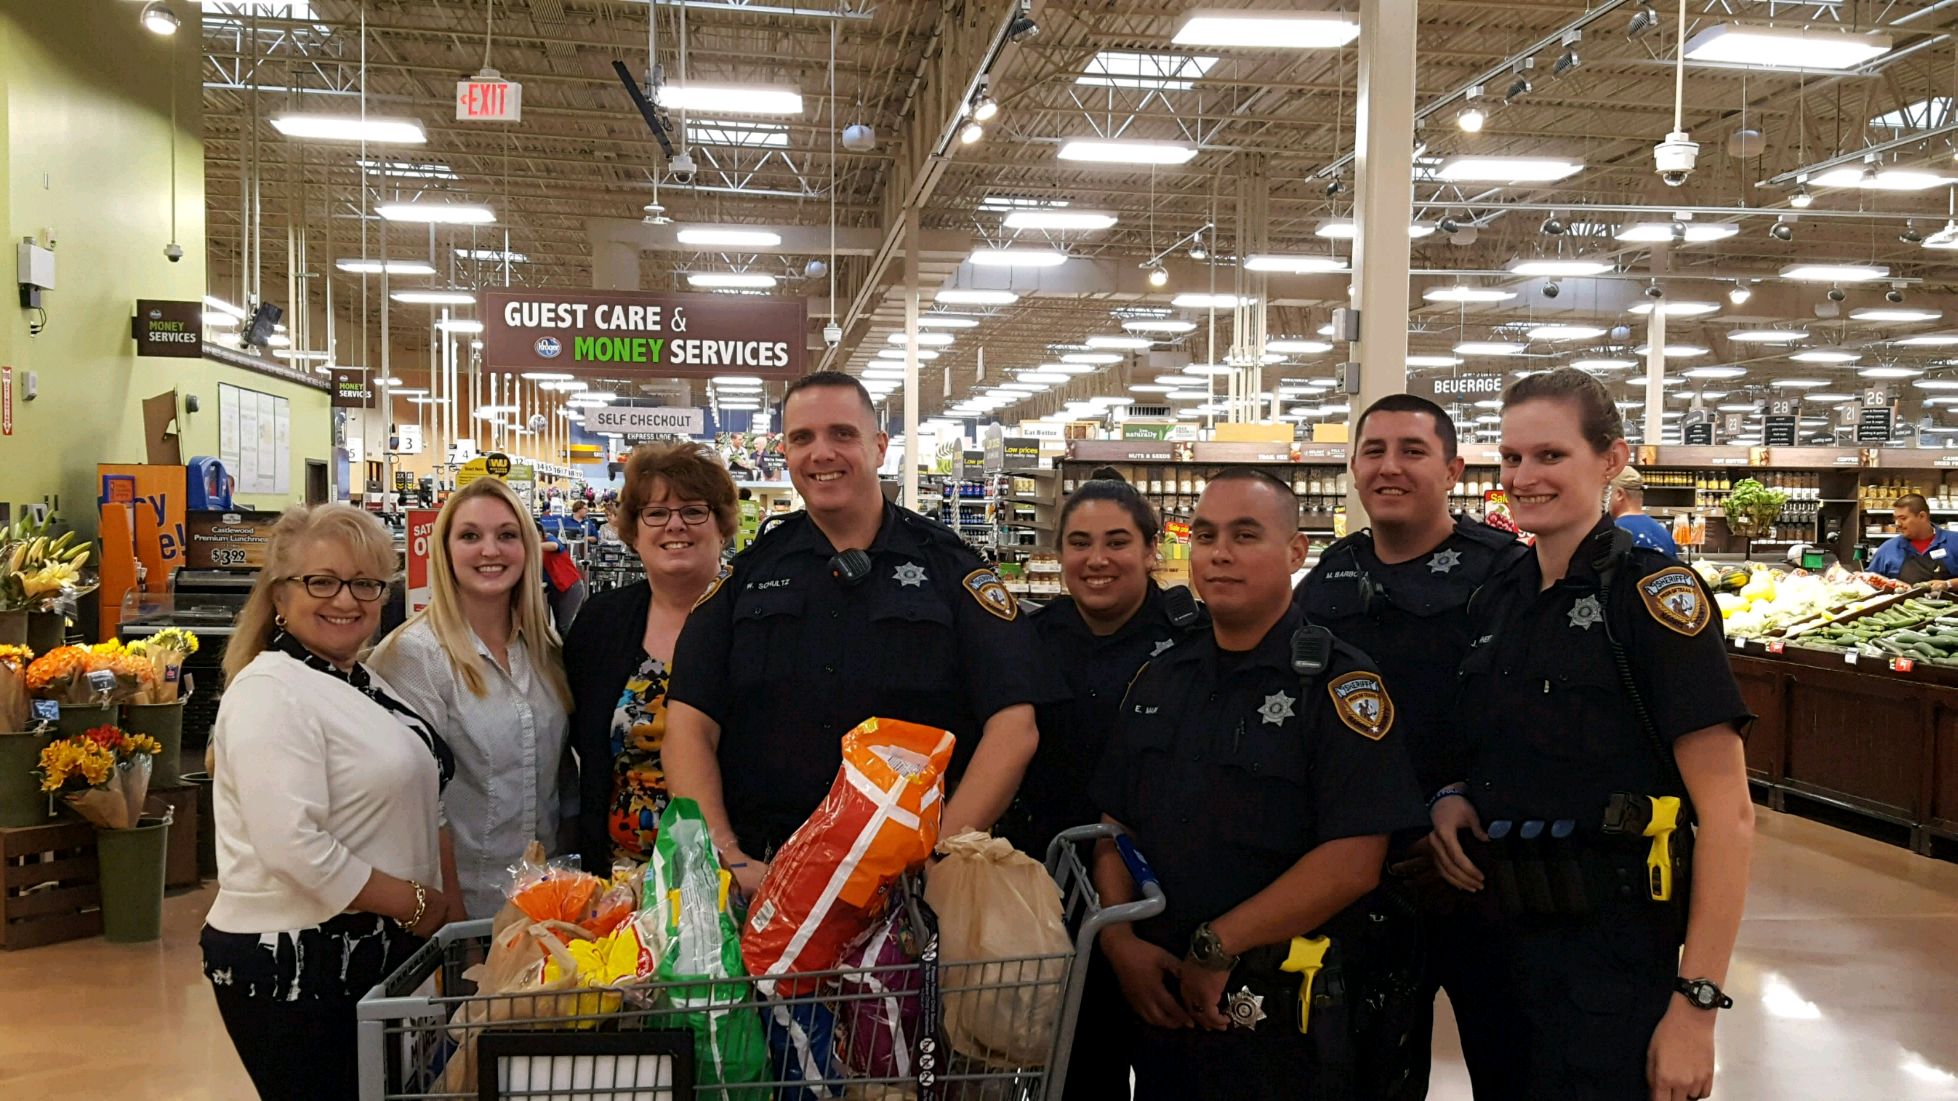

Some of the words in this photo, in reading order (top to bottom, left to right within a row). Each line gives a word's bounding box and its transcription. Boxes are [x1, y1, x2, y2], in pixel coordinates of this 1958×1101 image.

[468, 84, 508, 115] EXIT
[504, 301, 588, 329] GUEST
[594, 304, 662, 331] CARE
[670, 307, 687, 332] &
[149, 320, 185, 331] MONEY
[148, 331, 197, 343] SERVICES
[574, 336, 664, 363] MONEY
[669, 340, 789, 367] SERVICES
[339, 382, 363, 391] MONEY
[1433, 378, 1502, 394] BEVERAGE
[339, 390, 372, 399] SERVICS
[1866, 391, 1884, 405] 26
[1773, 402, 1789, 414] 28
[598, 413, 627, 425] SELF
[630, 413, 691, 428] CHECKOUT
[404, 437, 413, 450] 3
[462, 450, 469, 460] 4
[1004, 446, 1018, 454] Low
[1018, 447, 1039, 455] prices
[211, 526, 254, 534] Castlewood
[194, 534, 229, 542] Premium
[758, 578, 791, 590] SCHULTZ
[1655, 575, 1685, 588] SHERIFF
